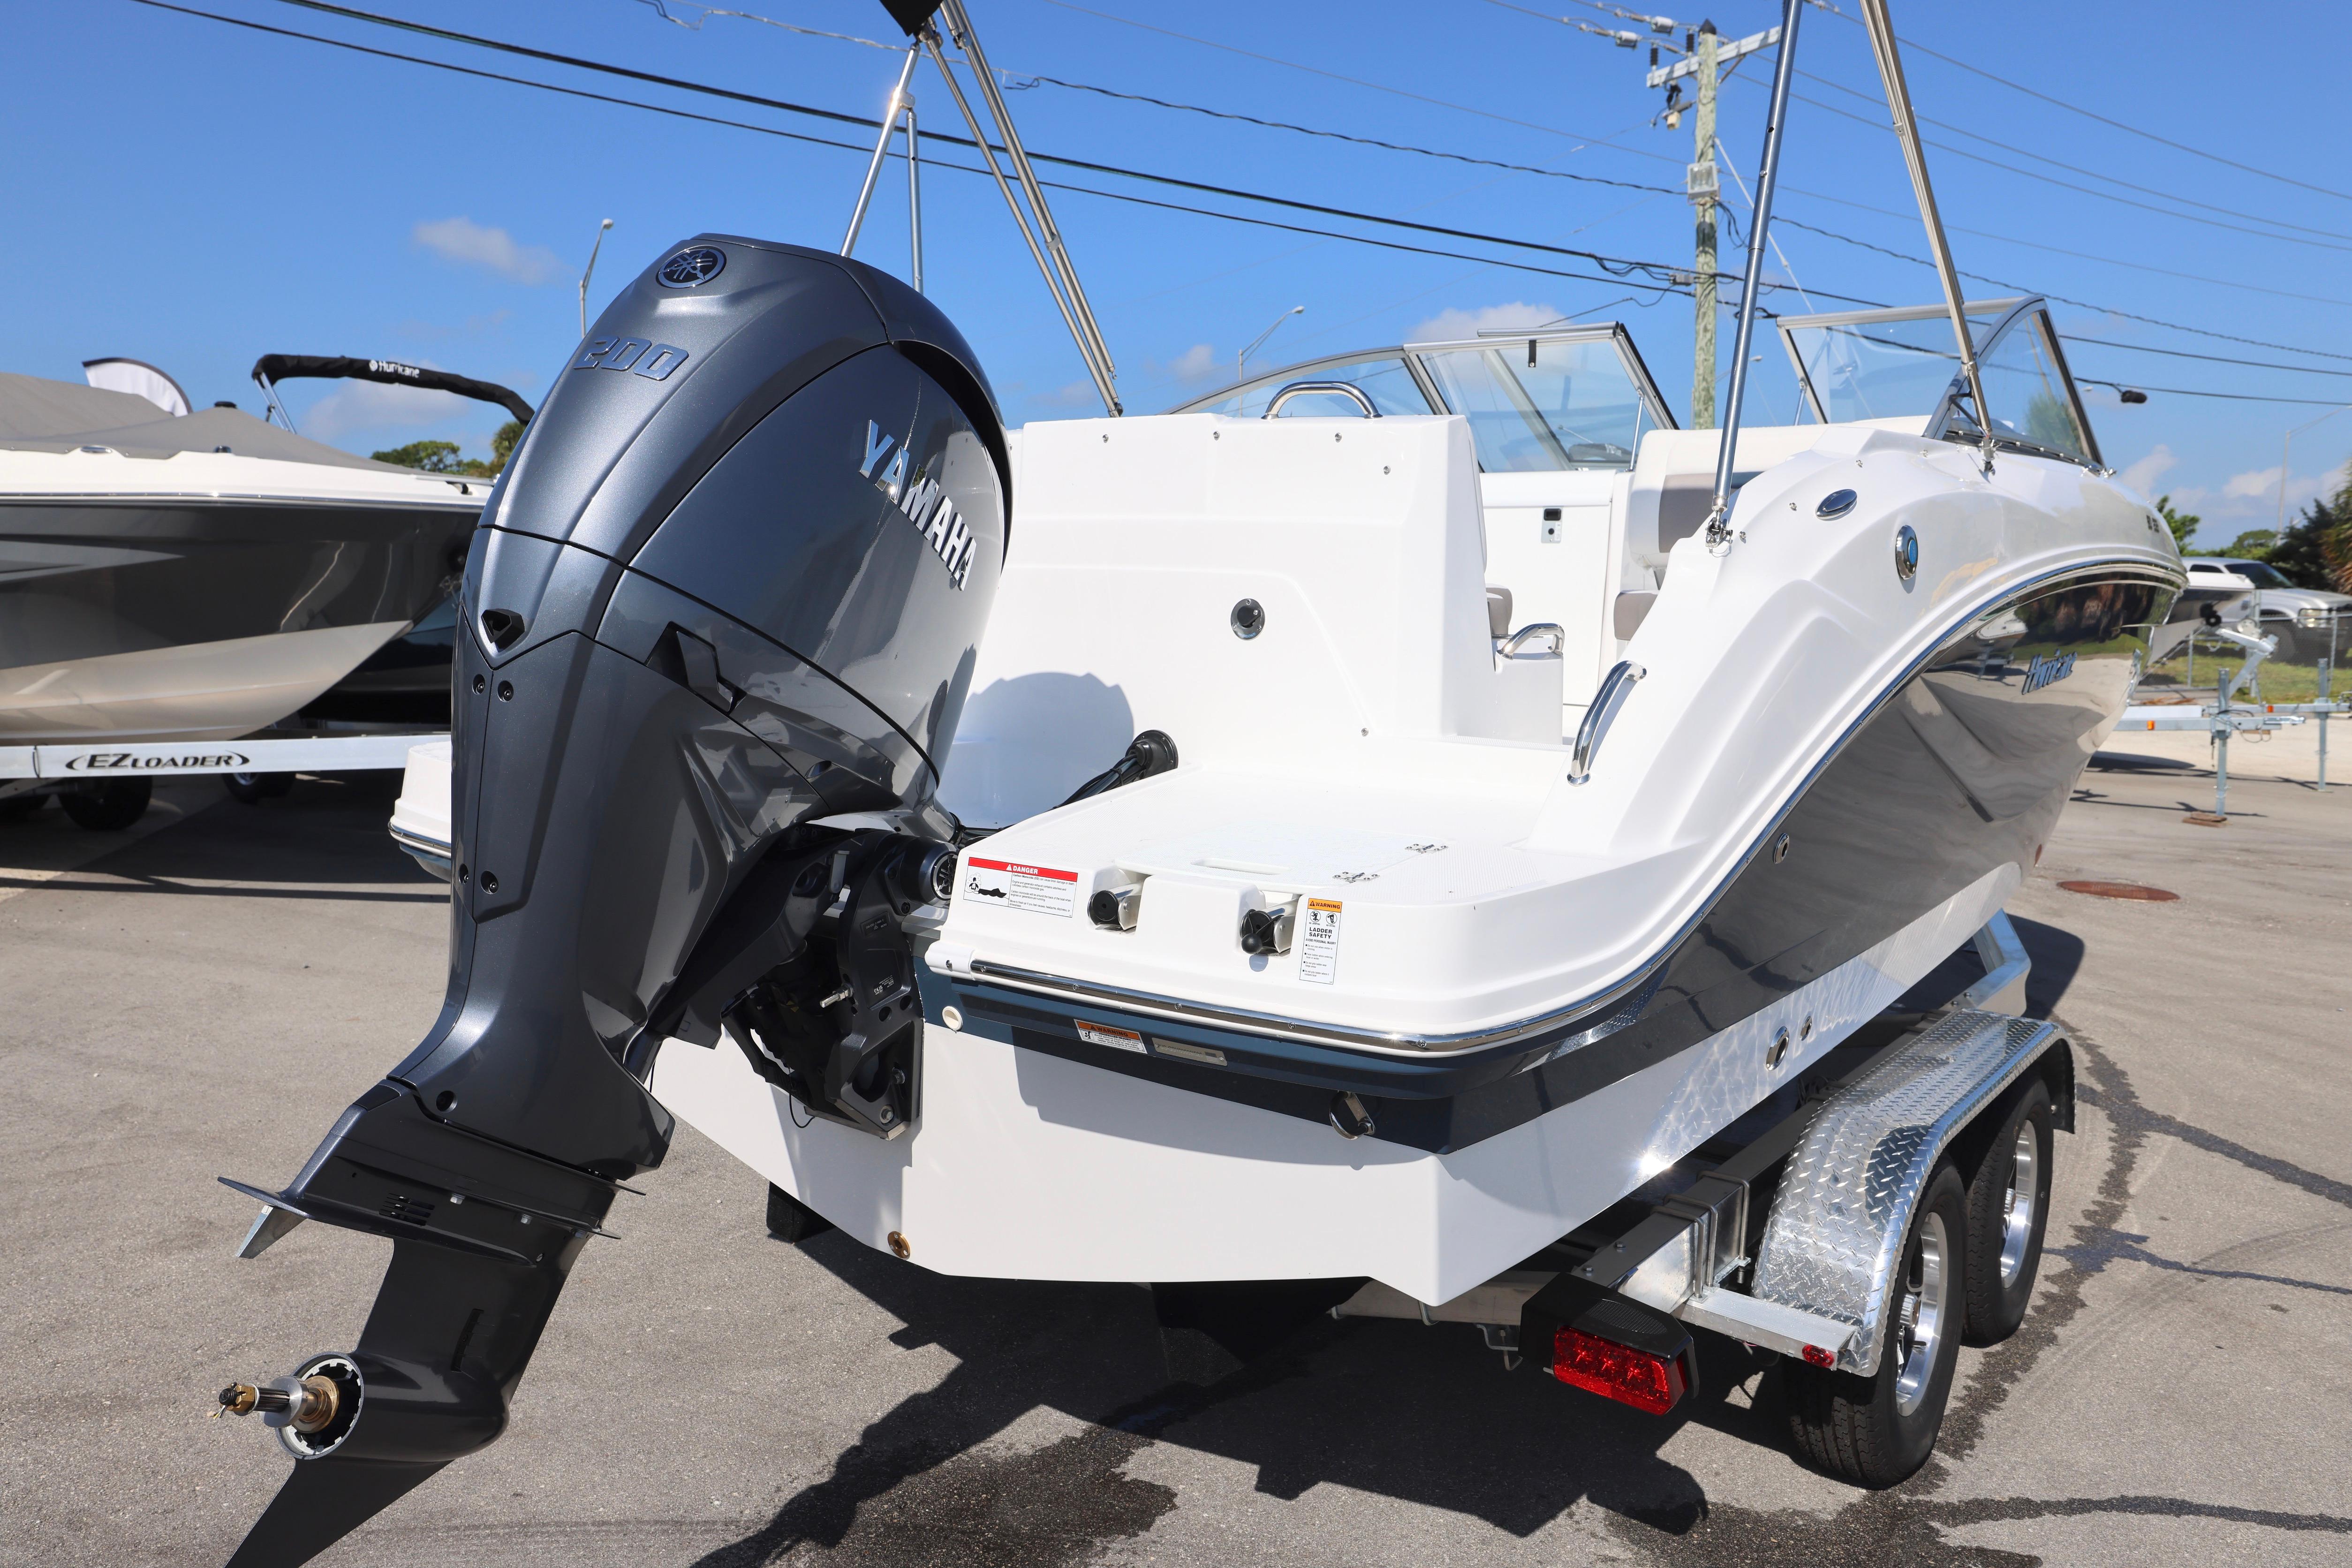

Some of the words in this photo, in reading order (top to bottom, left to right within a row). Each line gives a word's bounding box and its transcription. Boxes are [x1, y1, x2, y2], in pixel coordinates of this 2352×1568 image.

[573, 336, 689, 381] 200
[379, 361, 420, 378] Hurricane
[858, 419, 977, 592] YAMAHA
[1013, 865, 1038, 875] DANGER
[1096, 1026, 1128, 1037] WARNING
